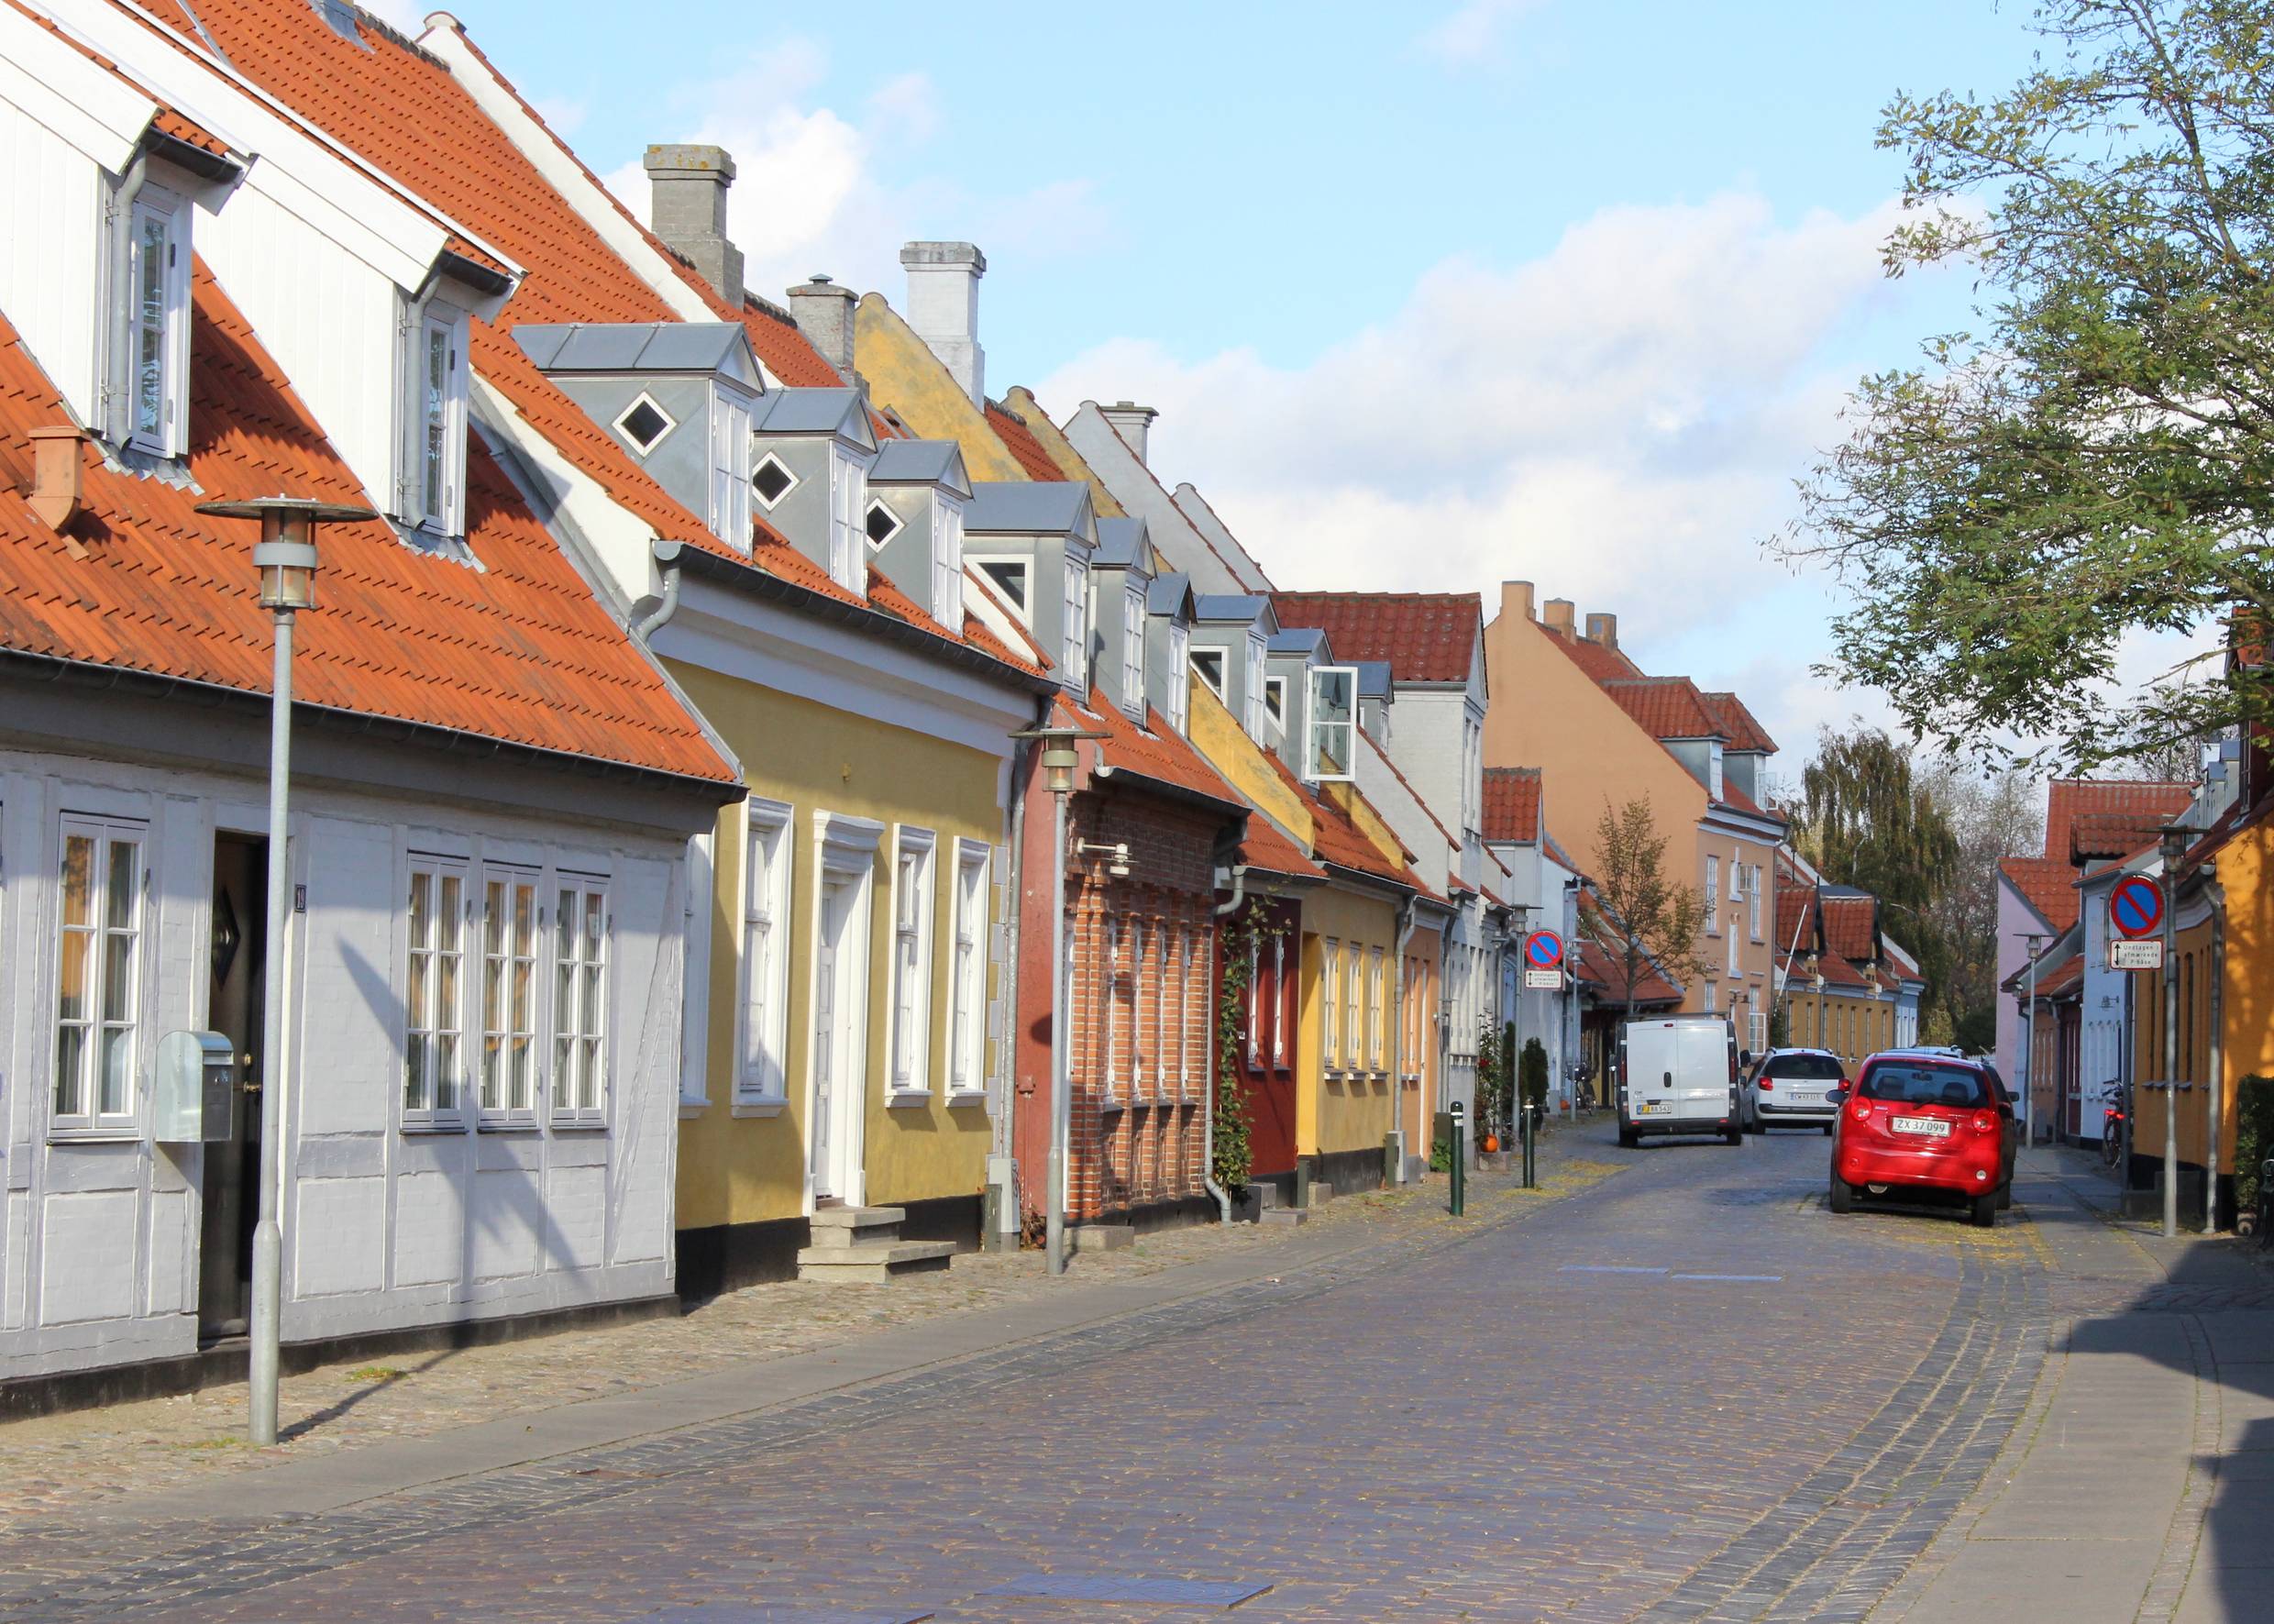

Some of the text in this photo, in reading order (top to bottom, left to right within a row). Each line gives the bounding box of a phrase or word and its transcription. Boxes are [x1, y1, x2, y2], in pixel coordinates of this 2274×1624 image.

[297, 888, 304, 909] 19
[1898, 1120, 1945, 1132] ZX 37 099
